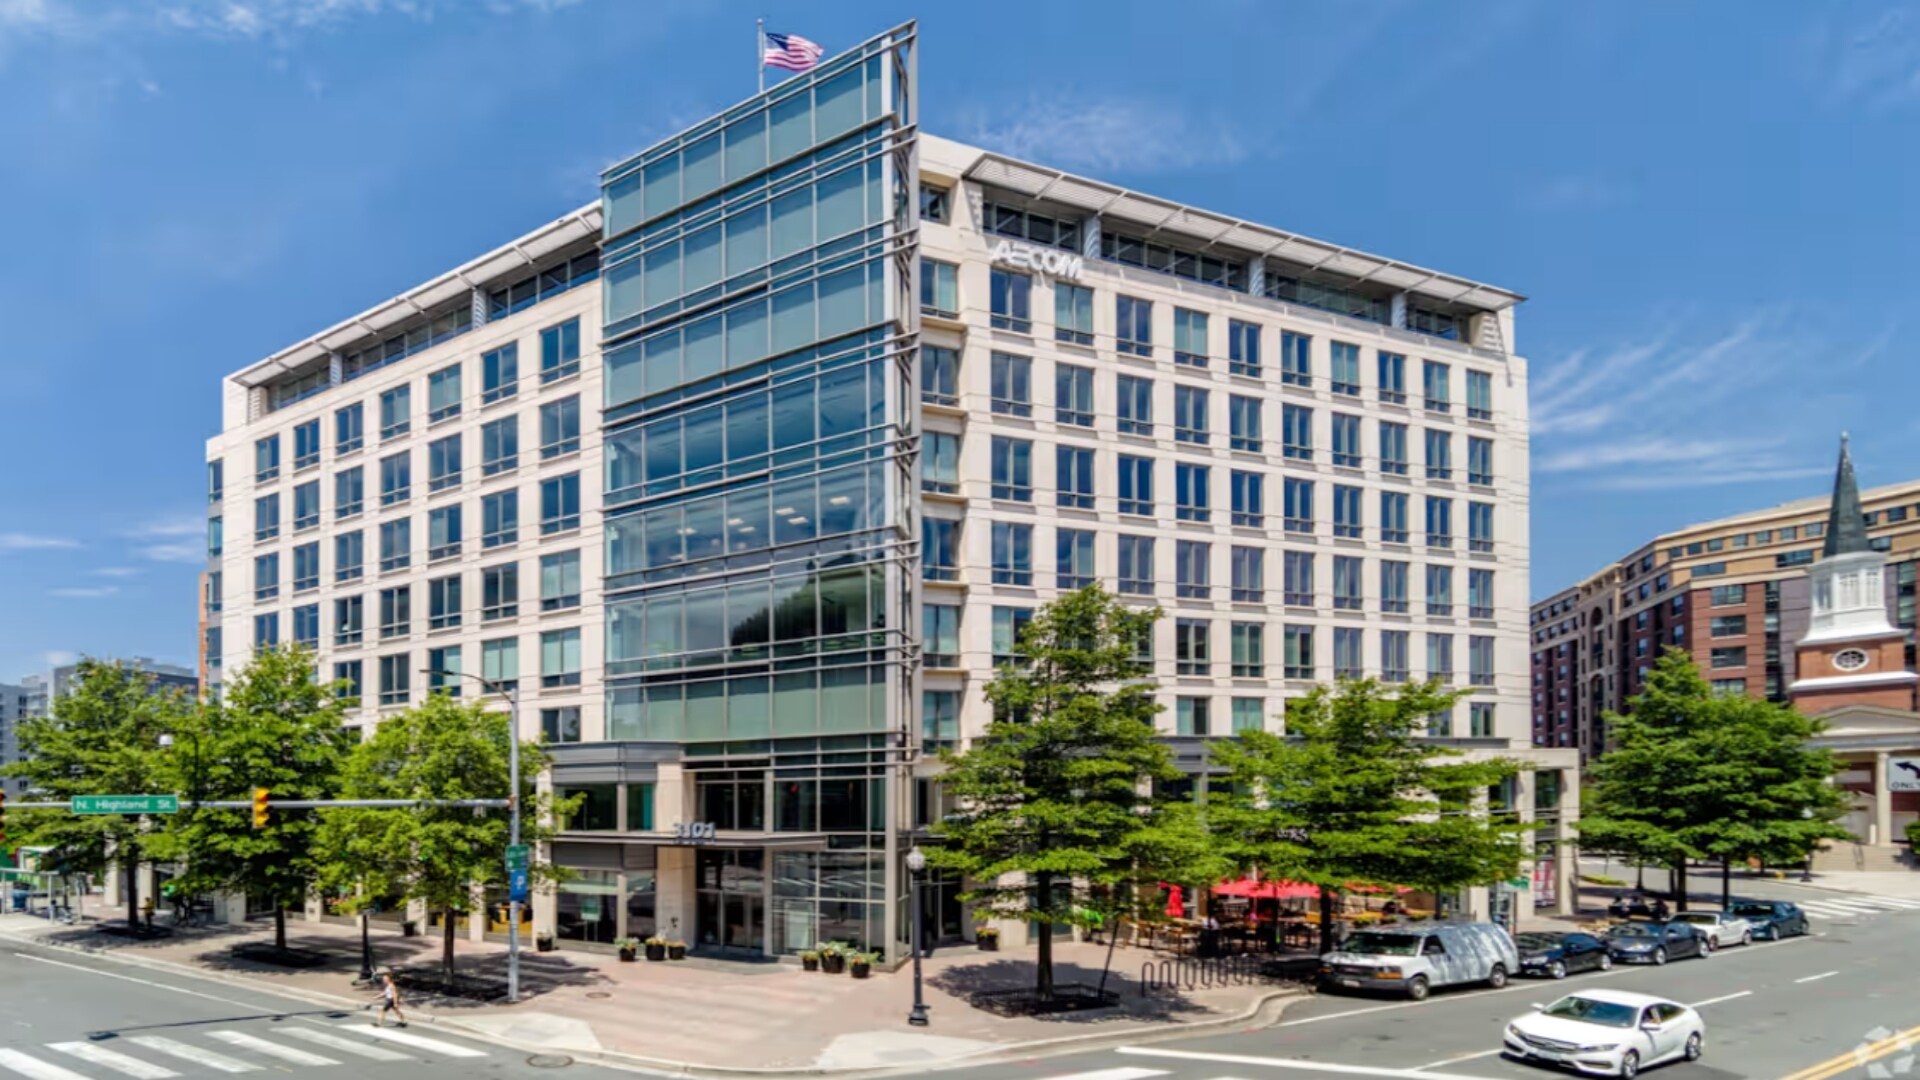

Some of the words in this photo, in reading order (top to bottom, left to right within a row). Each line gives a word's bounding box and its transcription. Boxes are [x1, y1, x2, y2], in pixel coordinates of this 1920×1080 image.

[992, 240, 1083, 280] AECOM
[76, 800, 90, 810] N.
[95, 800, 149, 813] Highland
[157, 799, 174, 810] St.
